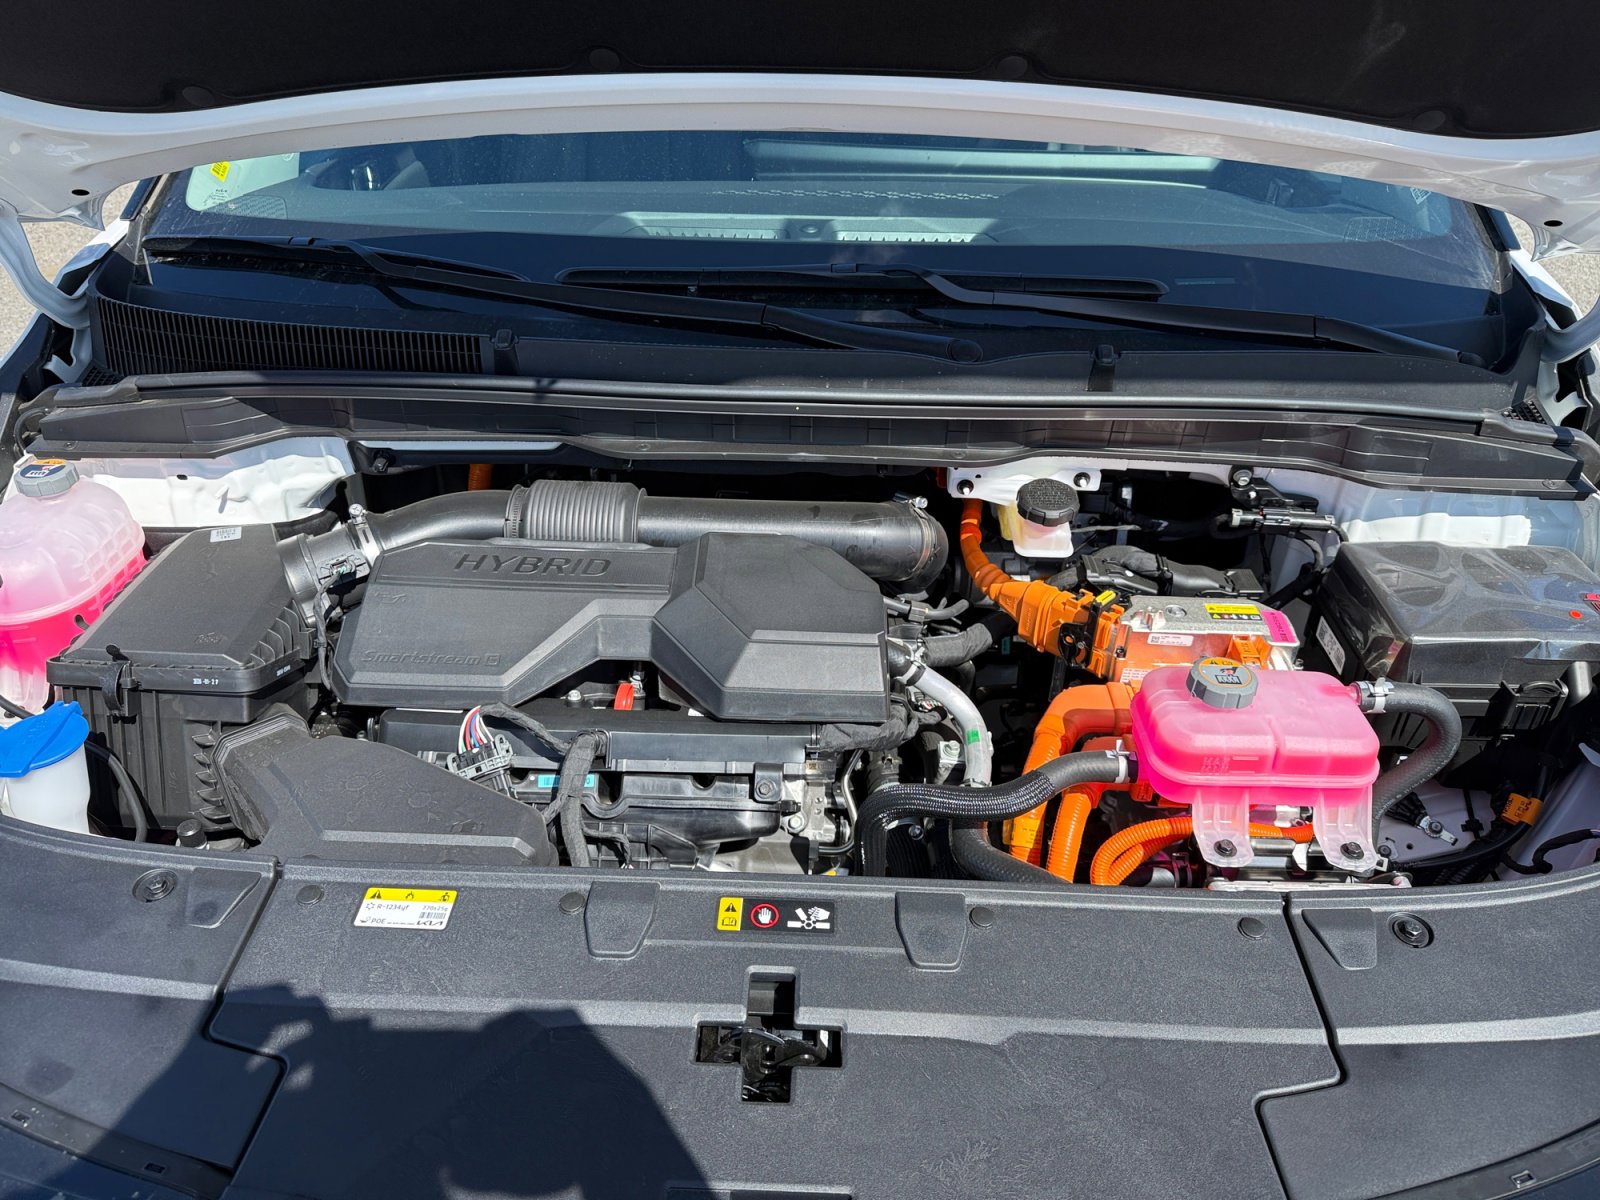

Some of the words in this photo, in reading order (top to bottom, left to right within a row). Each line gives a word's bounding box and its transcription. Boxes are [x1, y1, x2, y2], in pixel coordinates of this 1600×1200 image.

[453, 553, 612, 577] HYBRID
[361, 650, 481, 666] Smartstream
[376, 903, 410, 911] R-1234yf
